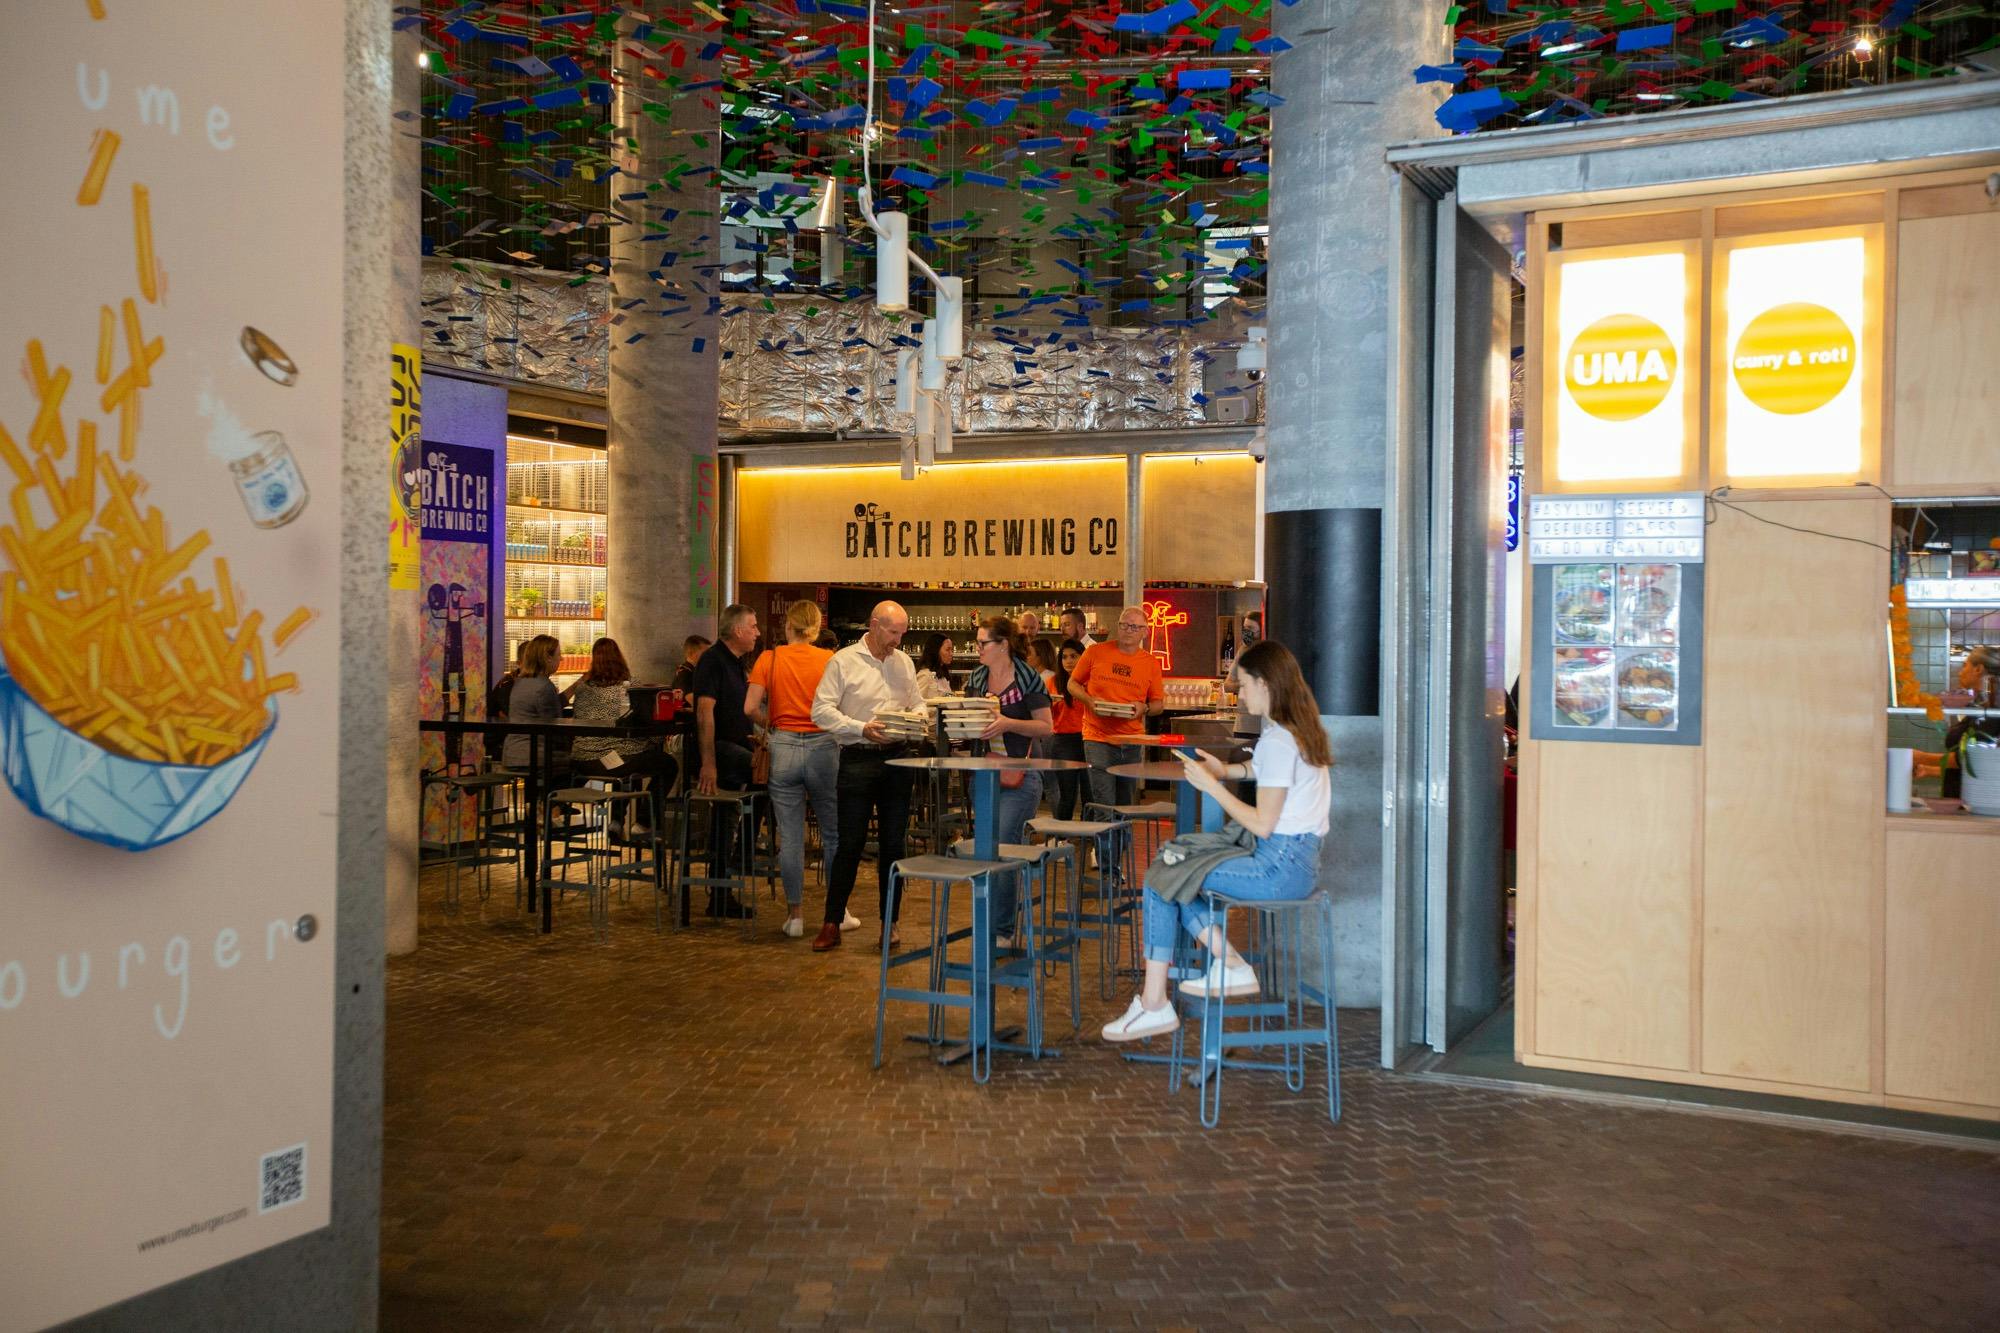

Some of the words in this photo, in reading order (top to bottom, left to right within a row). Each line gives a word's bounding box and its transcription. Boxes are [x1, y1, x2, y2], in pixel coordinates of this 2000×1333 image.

[77, 62, 236, 151] ume
[1573, 349, 1669, 386] UMA
[1734, 353, 1785, 372] curry
[1788, 350, 1803, 366] &
[1809, 347, 1849, 365] roti
[421, 469, 487, 511] BATCH
[421, 508, 473, 532] BREWING
[846, 519, 931, 558] BATCH
[943, 518, 1076, 557] BREWING
[1543, 521, 1614, 536] REFUGEE
